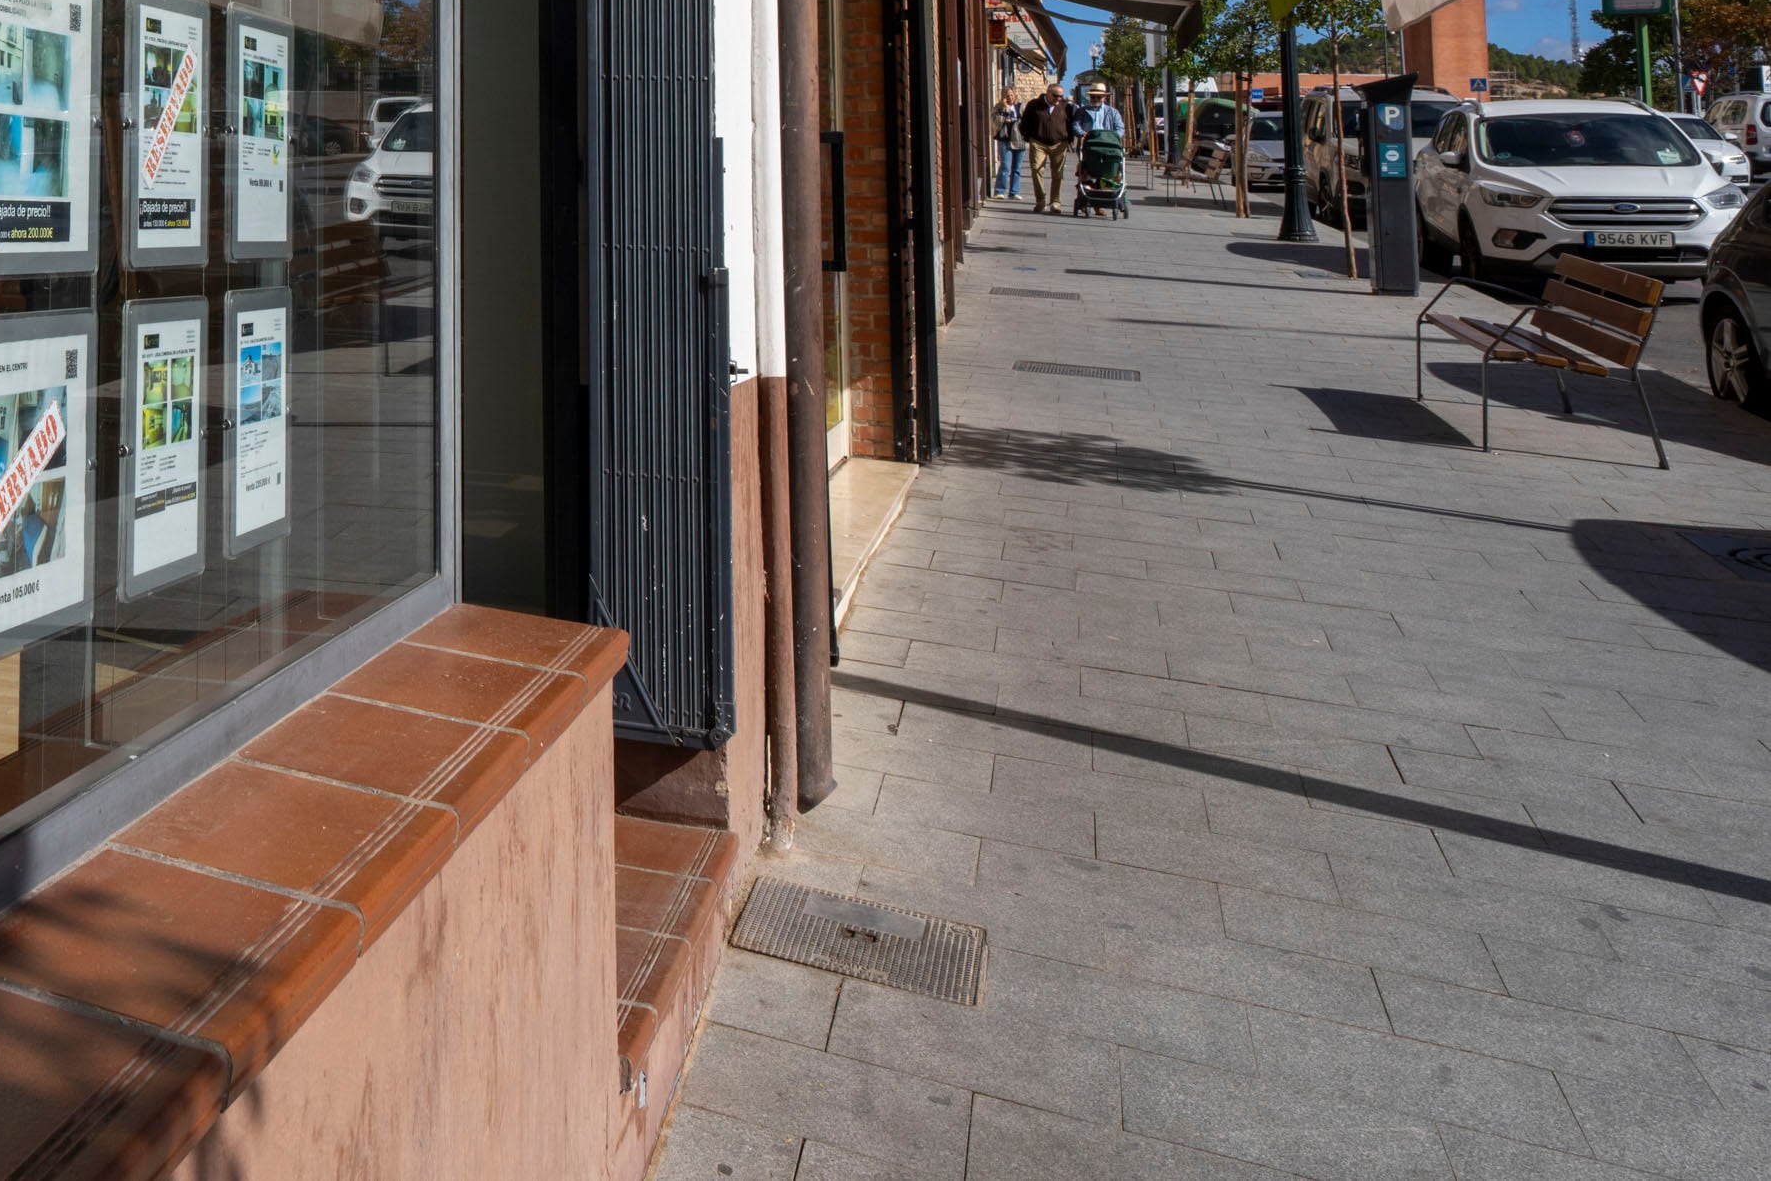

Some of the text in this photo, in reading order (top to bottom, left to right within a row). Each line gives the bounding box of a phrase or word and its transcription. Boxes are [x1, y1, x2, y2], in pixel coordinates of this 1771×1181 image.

[146, 54, 194, 179] RESERVADO
[1385, 106, 1400, 124] P
[17, 204, 25, 217] de
[27, 205, 51, 219] precio!!
[11, 227, 27, 238] ahora
[28, 227, 53, 238] 200.000€
[1598, 234, 1667, 245] 9546 KVF
